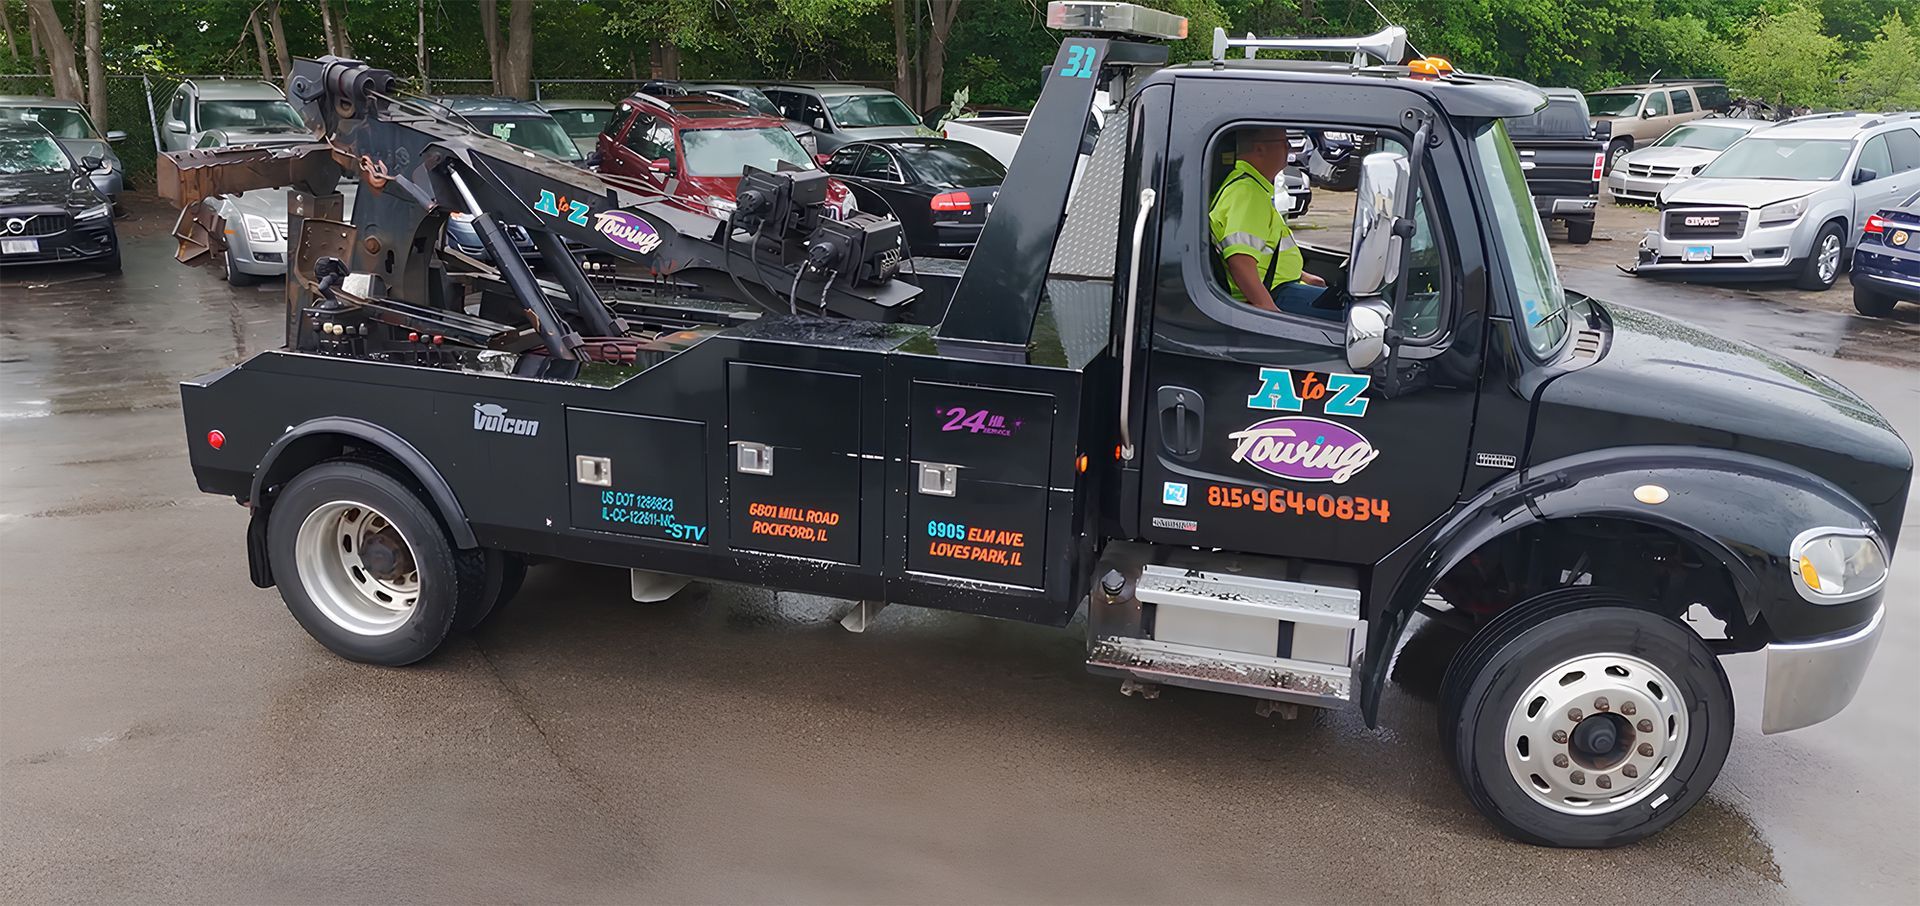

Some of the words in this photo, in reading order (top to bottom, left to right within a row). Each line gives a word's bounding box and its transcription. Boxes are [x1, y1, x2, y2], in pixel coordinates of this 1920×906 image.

[1060, 45, 1096, 78] 31
[534, 188, 559, 217] A
[567, 199, 589, 228] Z
[594, 213, 662, 254] Towing
[1247, 367, 1303, 412] A
[1301, 371, 1325, 400] to
[1324, 373, 1371, 417] Z
[942, 407, 989, 433] 24
[1228, 428, 1380, 484] Towing
[601, 490, 614, 504] US
[616, 492, 635, 507] DOT
[749, 502, 777, 518] 6801
[778, 507, 804, 522] MILL
[806, 510, 839, 526] ROAD
[664, 524, 706, 541] -STV
[752, 520, 815, 542] ROCKFORD,
[816, 528, 828, 542] IL
[927, 520, 965, 540] 6905
[967, 527, 996, 544] ELM
[929, 541, 971, 560] LOVES
[970, 546, 1009, 567] PARK,
[1010, 552, 1023, 566] IL
